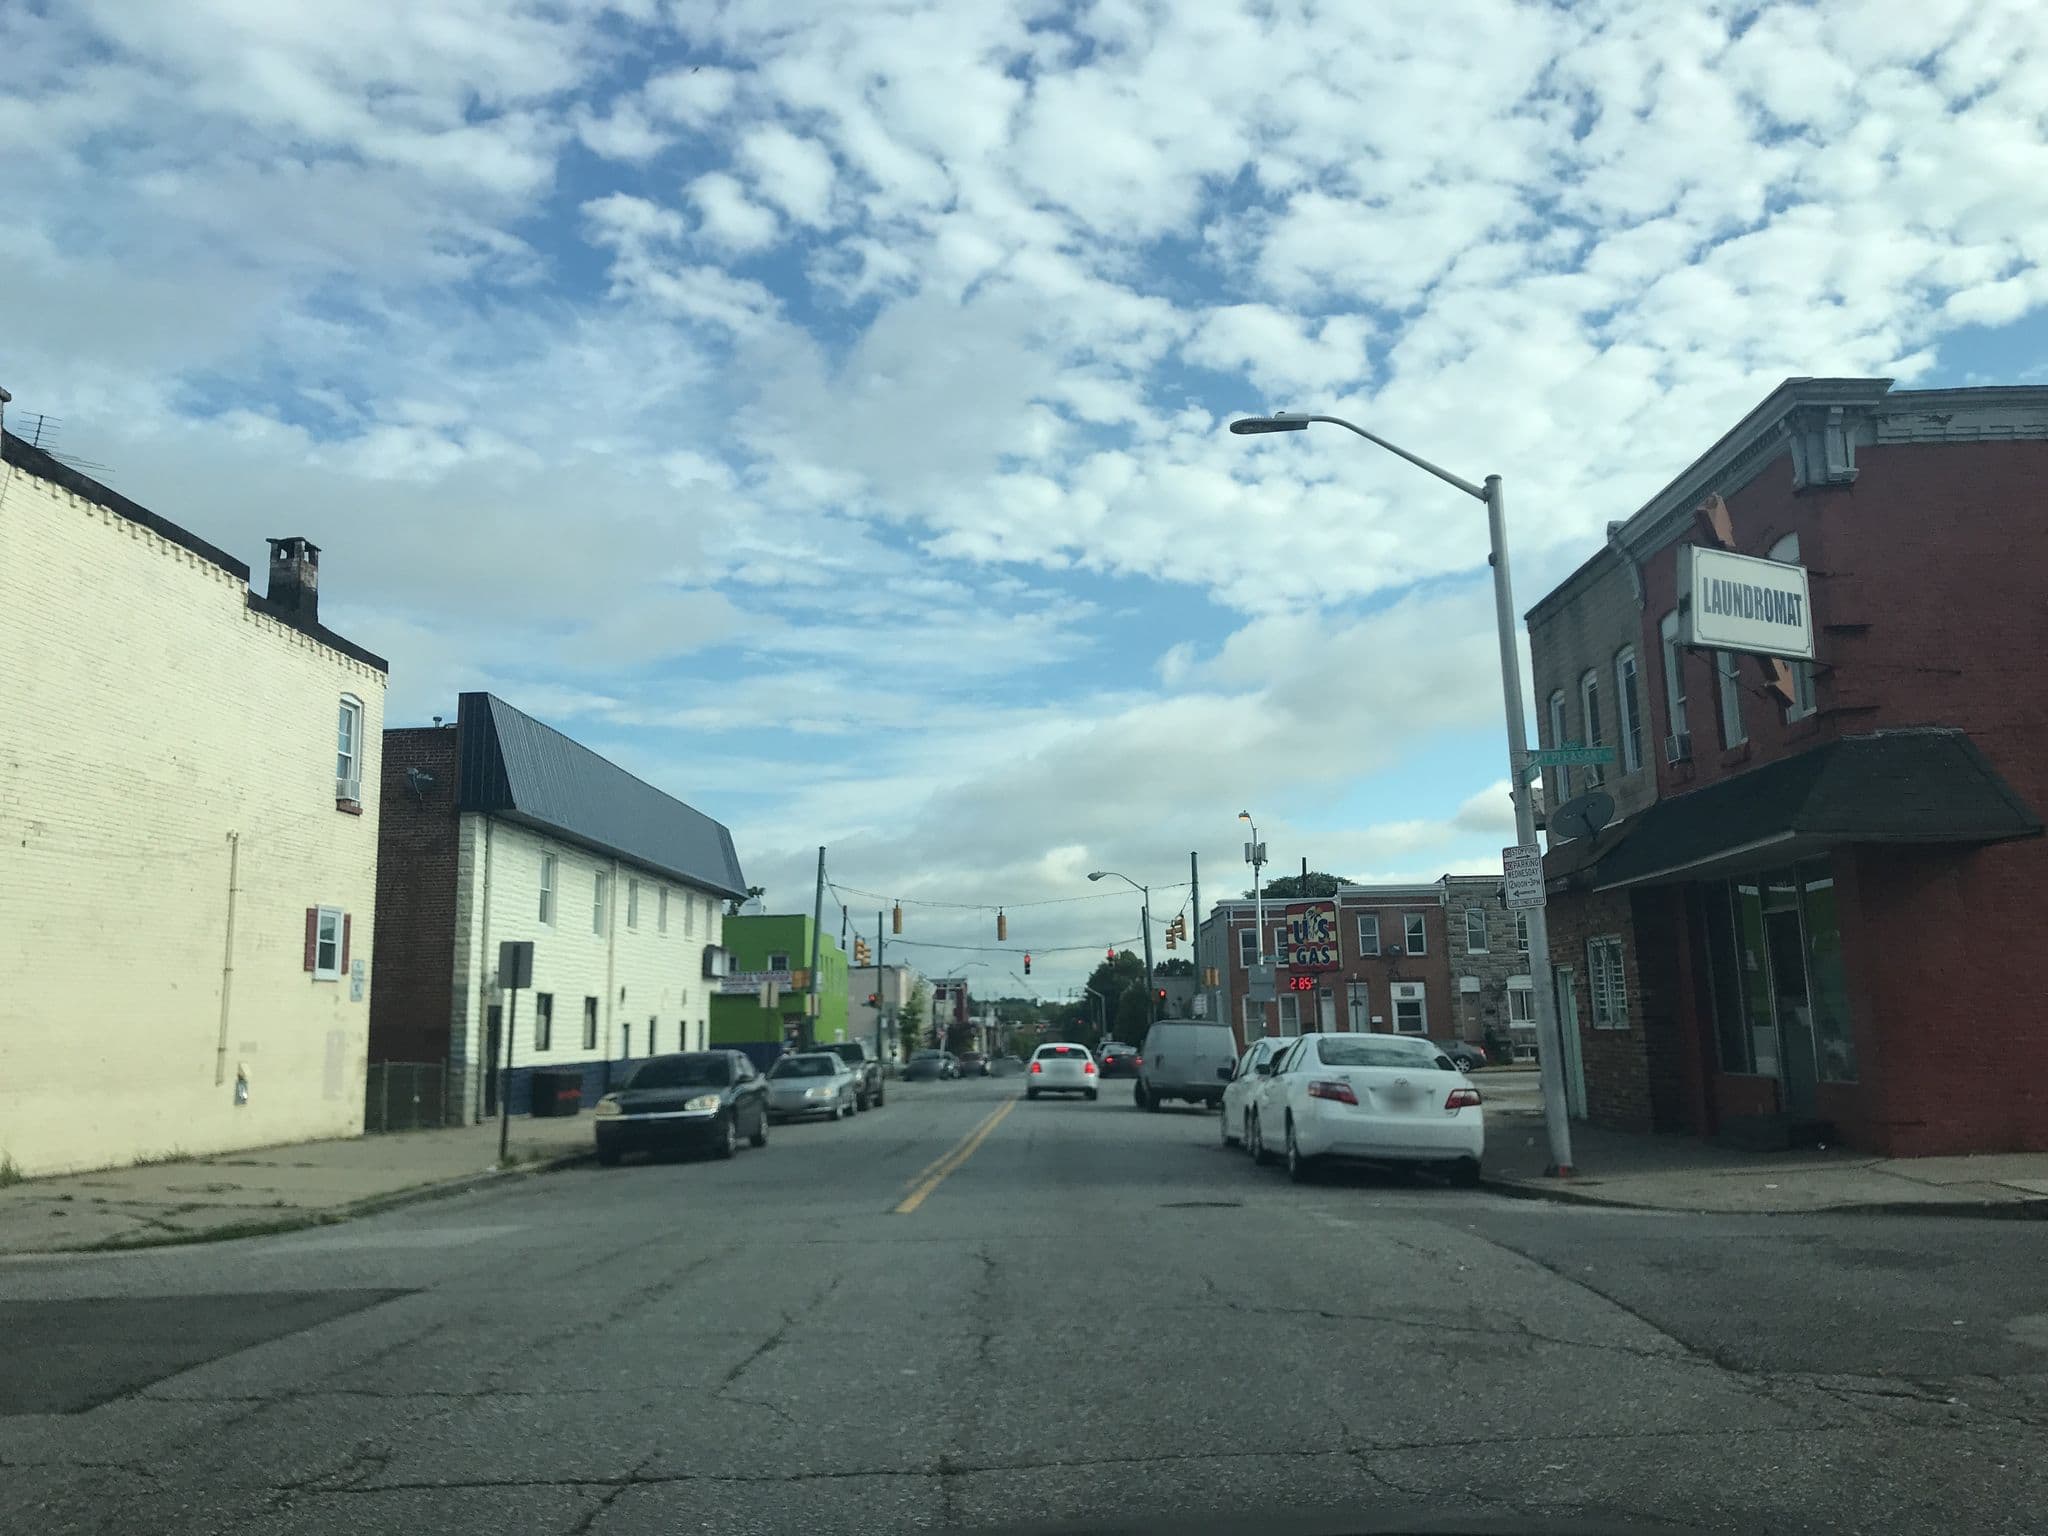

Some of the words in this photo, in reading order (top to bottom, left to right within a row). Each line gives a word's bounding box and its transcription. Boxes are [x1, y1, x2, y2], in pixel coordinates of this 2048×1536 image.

[1703, 577, 1802, 627] LAUNDROMAT
[1513, 859, 1539, 870] PARKING
[1507, 868, 1538, 879] WEDNESDAY
[1296, 945, 1331, 966] GAS
